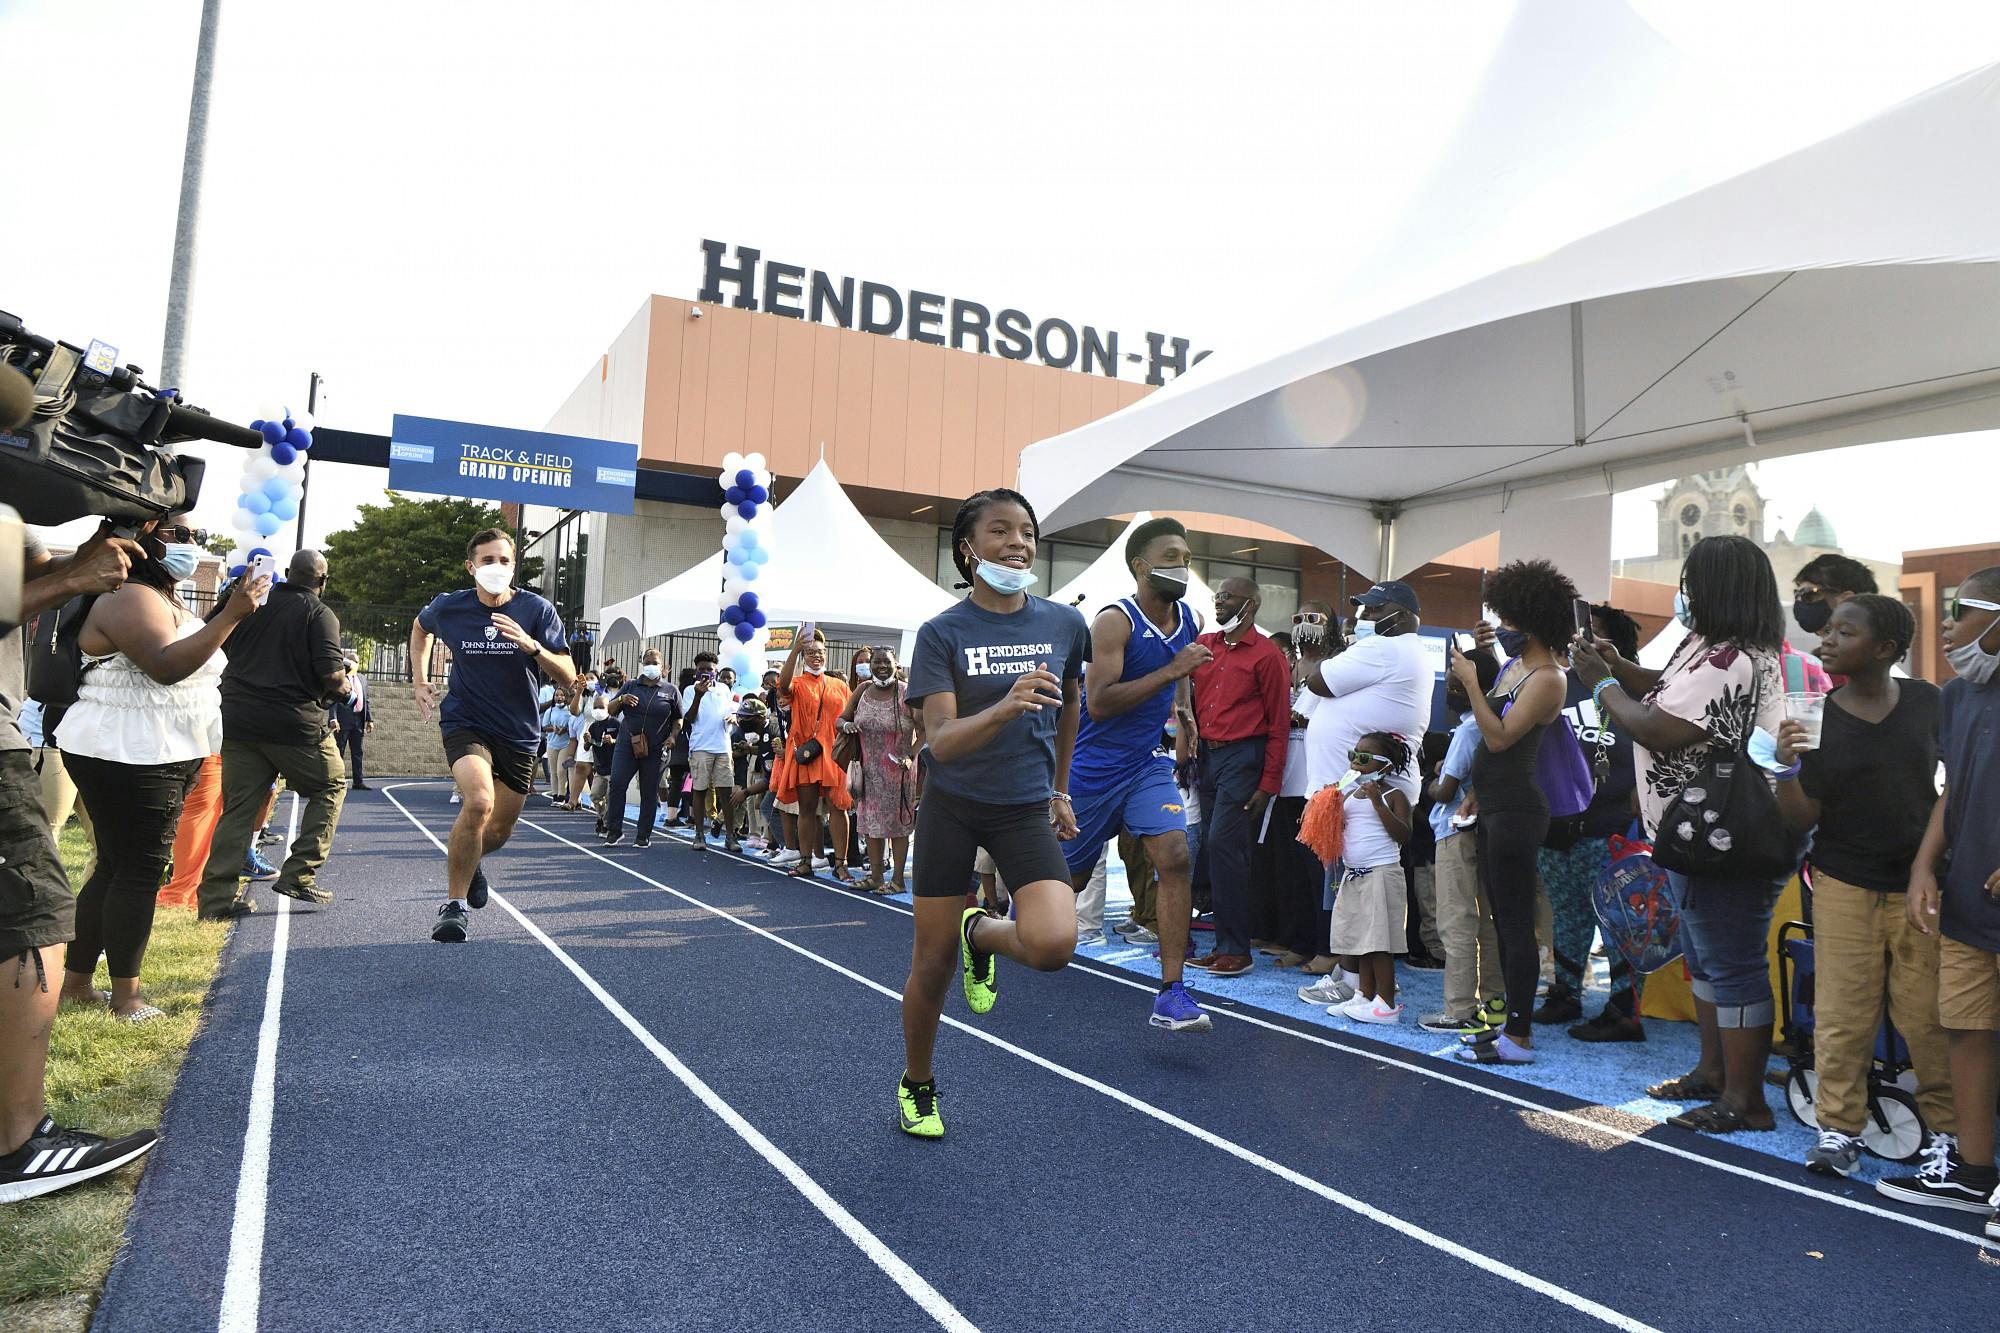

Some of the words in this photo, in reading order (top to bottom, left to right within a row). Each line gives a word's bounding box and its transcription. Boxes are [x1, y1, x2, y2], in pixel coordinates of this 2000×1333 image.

[461, 444, 514, 462] TRACK
[518, 451, 529, 464] &
[534, 453, 573, 469] FIELD
[459, 461, 506, 480] GRAND
[512, 466, 572, 488] OPENING
[460, 641, 485, 649] JOHNS
[486, 641, 519, 649] HOPKINS
[964, 643, 1053, 676] HENDERSON
